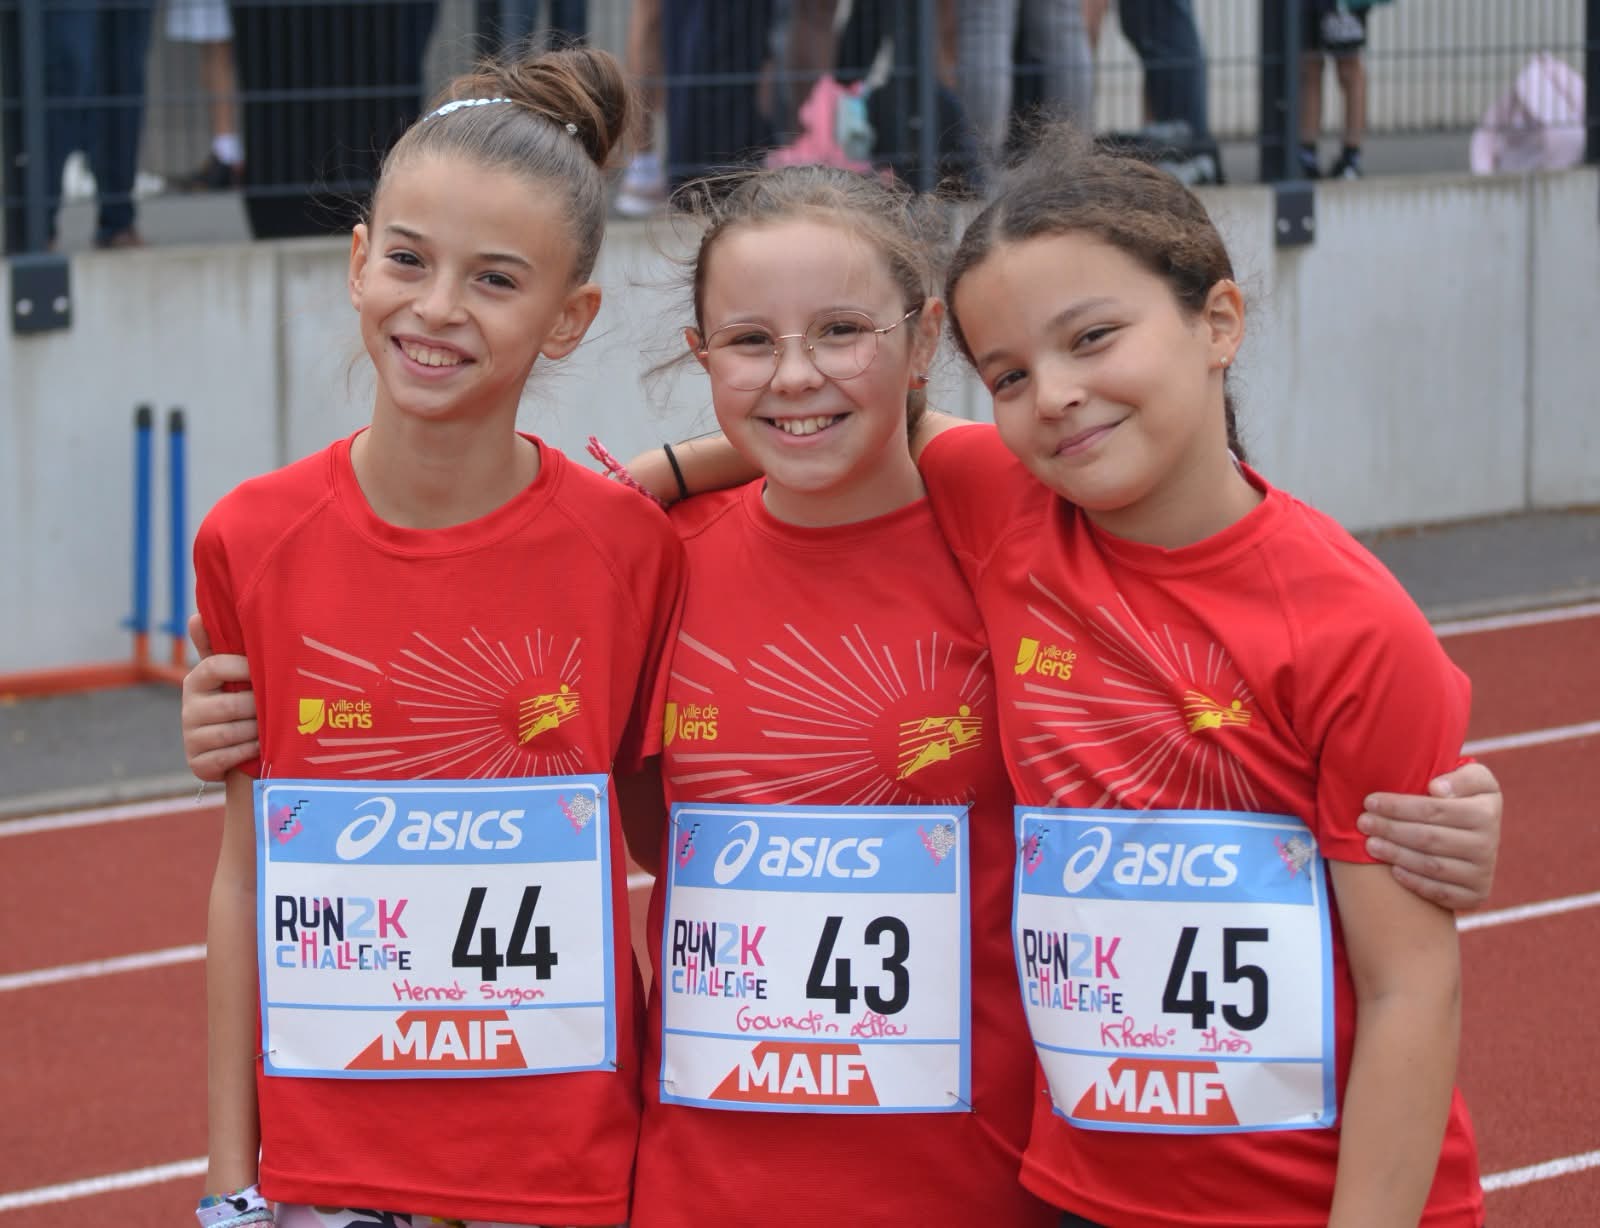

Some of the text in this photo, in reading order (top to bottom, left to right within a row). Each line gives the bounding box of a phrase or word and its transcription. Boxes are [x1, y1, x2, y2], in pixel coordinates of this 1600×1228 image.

[1061, 649, 1077, 662] de
[331, 700, 372, 712] ville de
[682, 704, 719, 719] ville de
[276, 931, 412, 970] CHALLENGE
[452, 885, 558, 982] 44
[671, 956, 767, 1000] CHALLENGE
[806, 916, 910, 1015] 43
[1162, 926, 1269, 1031] 45
[1028, 967, 1123, 1014] CHALLENGE
[382, 1020, 514, 1061] MAIF
[736, 1005, 839, 1035] Gourdin
[737, 1052, 865, 1096] MAIF
[1095, 1069, 1224, 1116] MAIF
